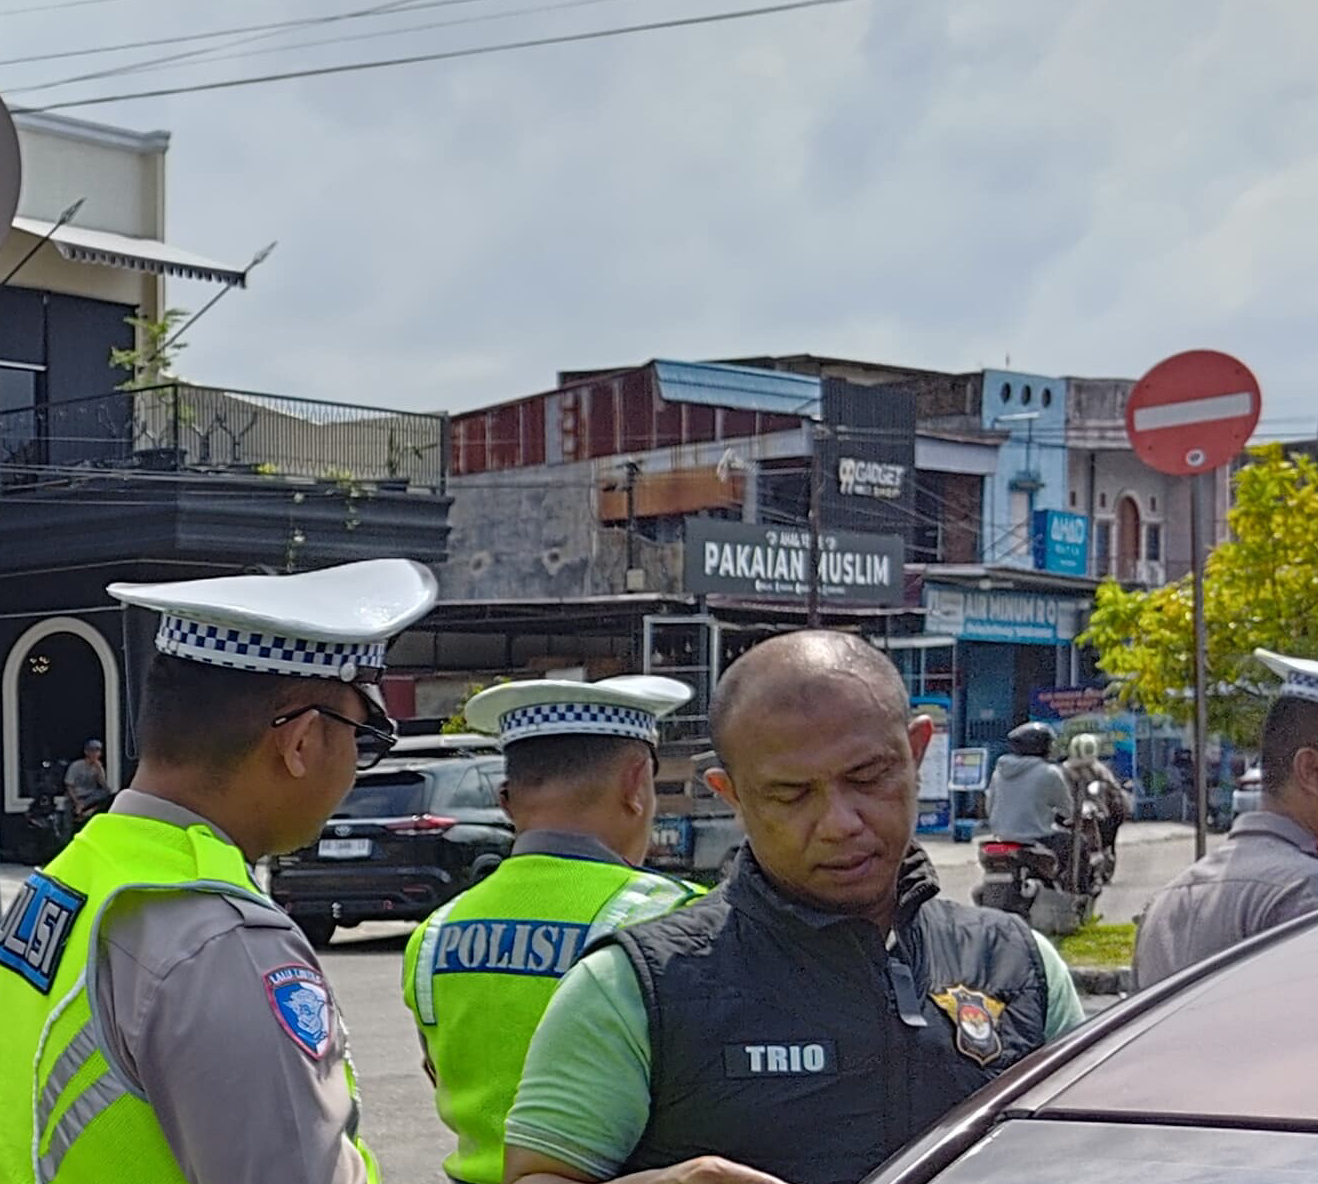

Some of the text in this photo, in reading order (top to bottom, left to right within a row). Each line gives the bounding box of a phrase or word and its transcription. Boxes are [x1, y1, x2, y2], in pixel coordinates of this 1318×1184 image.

[704, 541, 804, 580] PAKAIAN
[817, 551, 890, 586] MUSLIM
[966, 591, 988, 619] AIR
[989, 594, 1035, 624] MINUM
[435, 922, 581, 973] POLISI
[745, 1044, 824, 1072] TRIO
